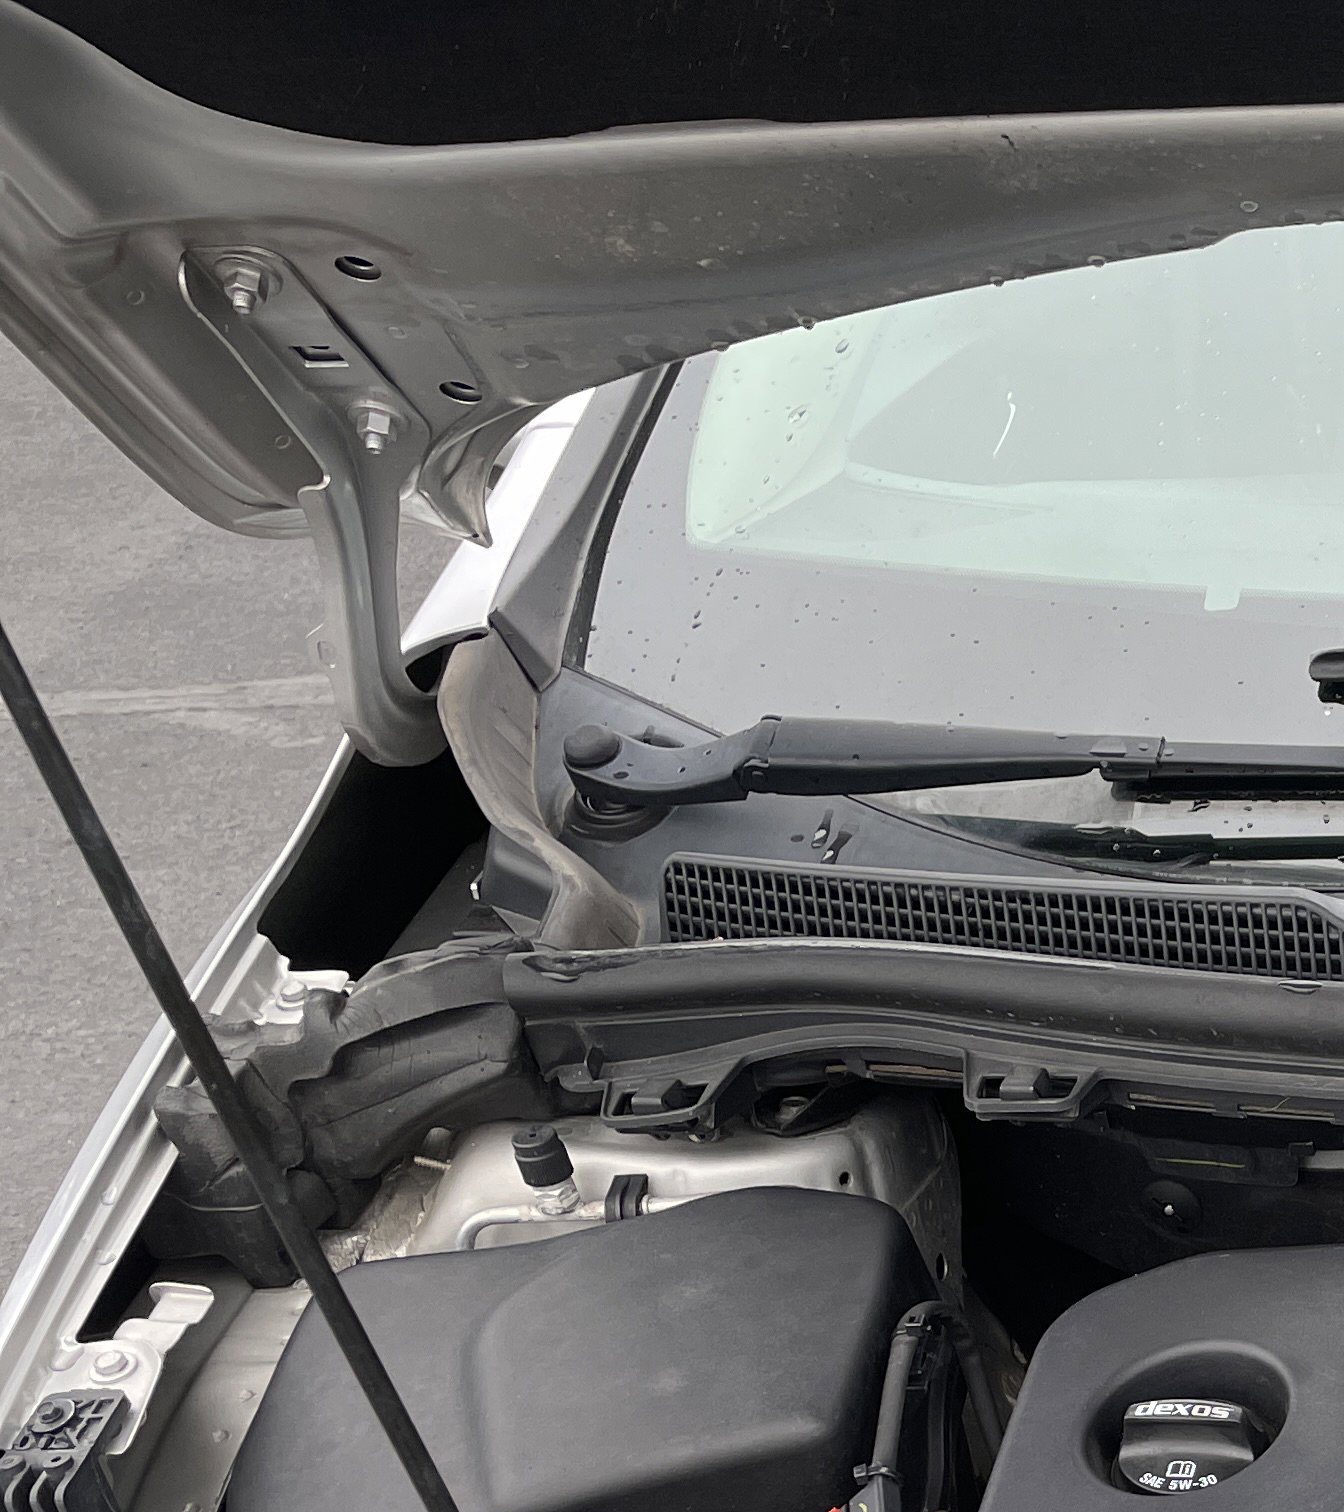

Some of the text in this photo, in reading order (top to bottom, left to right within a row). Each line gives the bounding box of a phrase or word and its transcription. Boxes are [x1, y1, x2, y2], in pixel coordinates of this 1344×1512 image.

[1134, 1401, 1232, 1419] dexos
[1138, 1472, 1219, 1491] SAE 5W-30
